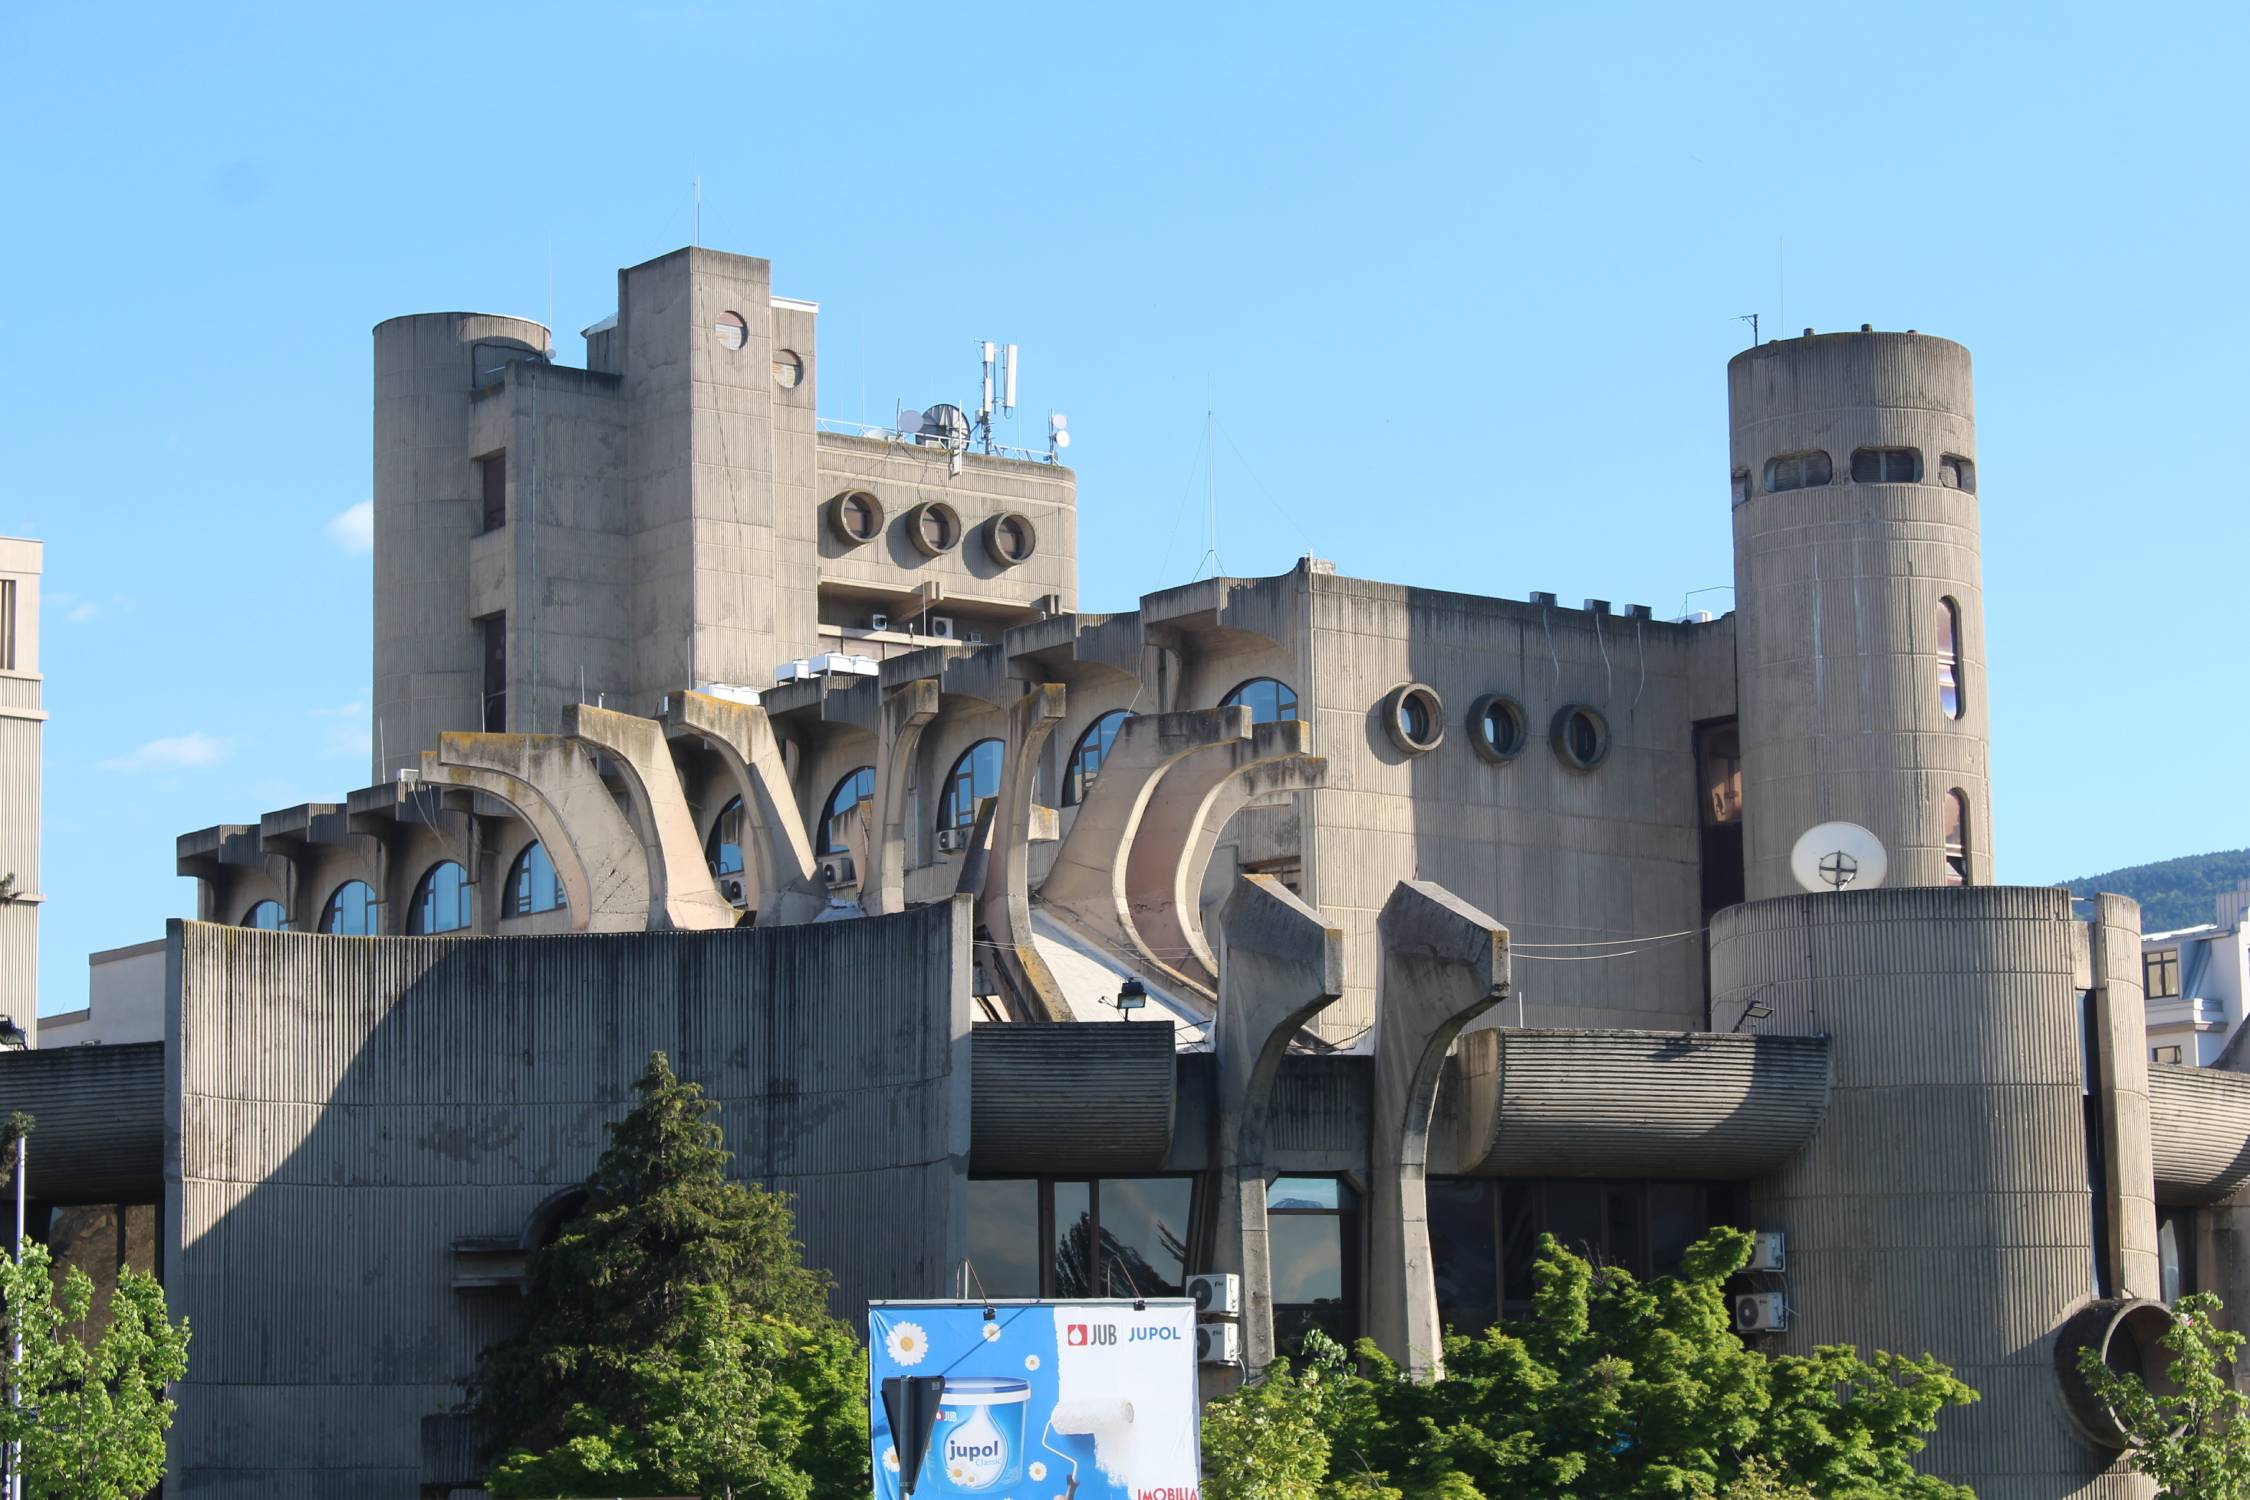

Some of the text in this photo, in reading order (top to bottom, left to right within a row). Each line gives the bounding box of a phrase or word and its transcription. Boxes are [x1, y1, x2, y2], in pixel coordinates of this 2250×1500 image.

[1091, 1324, 1181, 1346] JUB JUPOL
[949, 1440, 999, 1461] jupol
